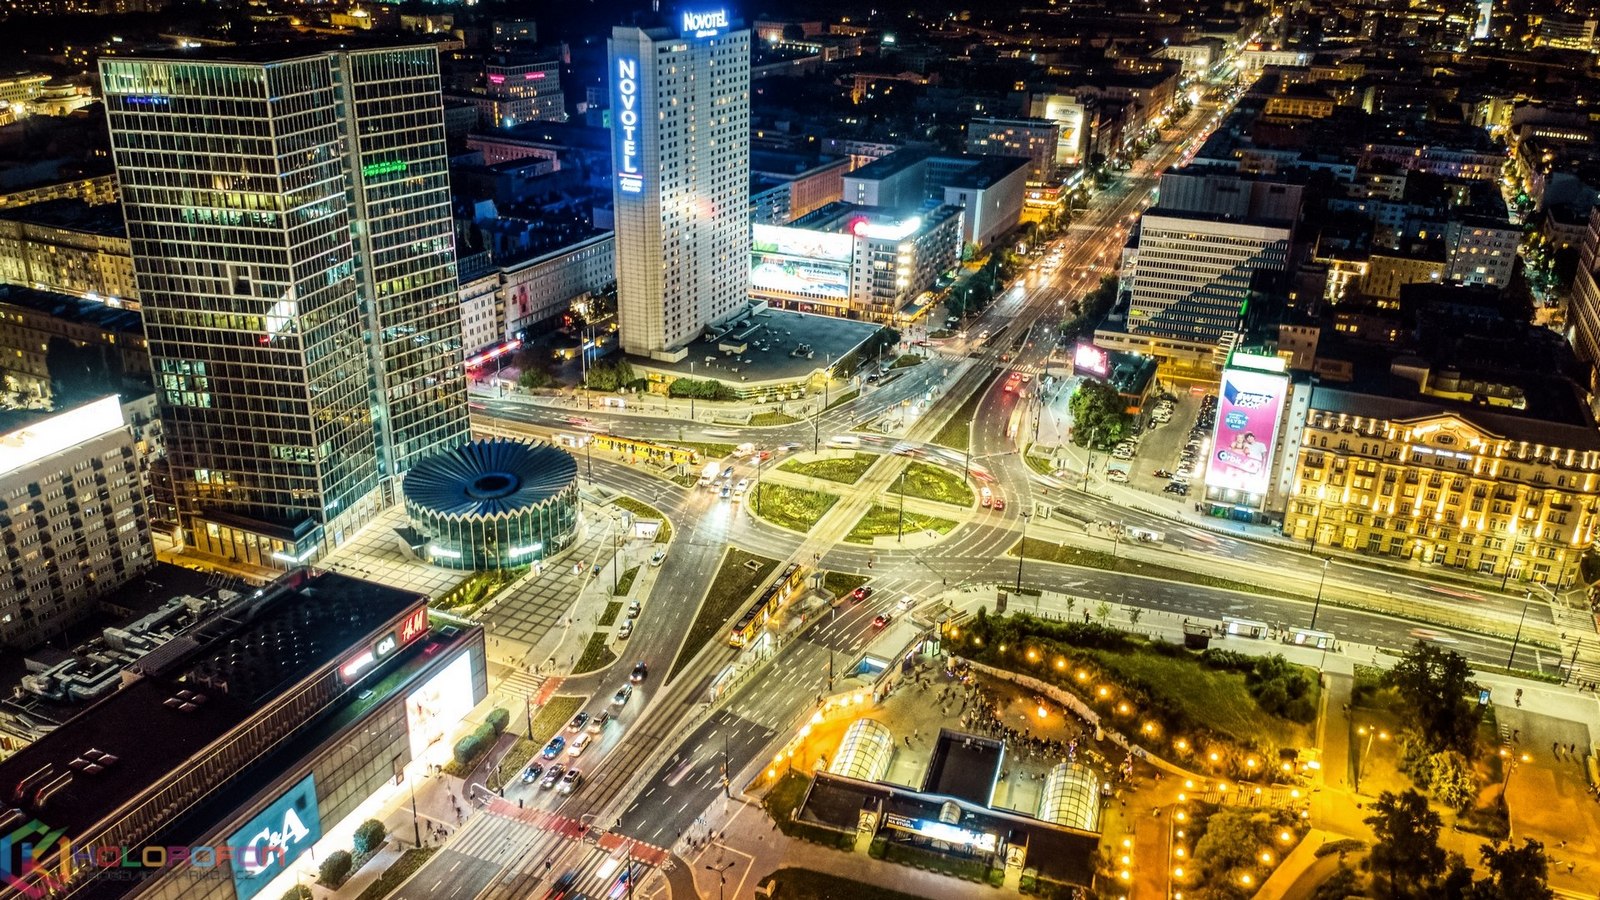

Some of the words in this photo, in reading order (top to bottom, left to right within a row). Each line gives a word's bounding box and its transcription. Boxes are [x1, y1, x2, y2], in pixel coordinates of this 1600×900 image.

[683, 10, 728, 31] NOVOTEL
[619, 59, 637, 173] NOVOTEL
[403, 610, 424, 642] H&M
[243, 807, 310, 876] C&A
